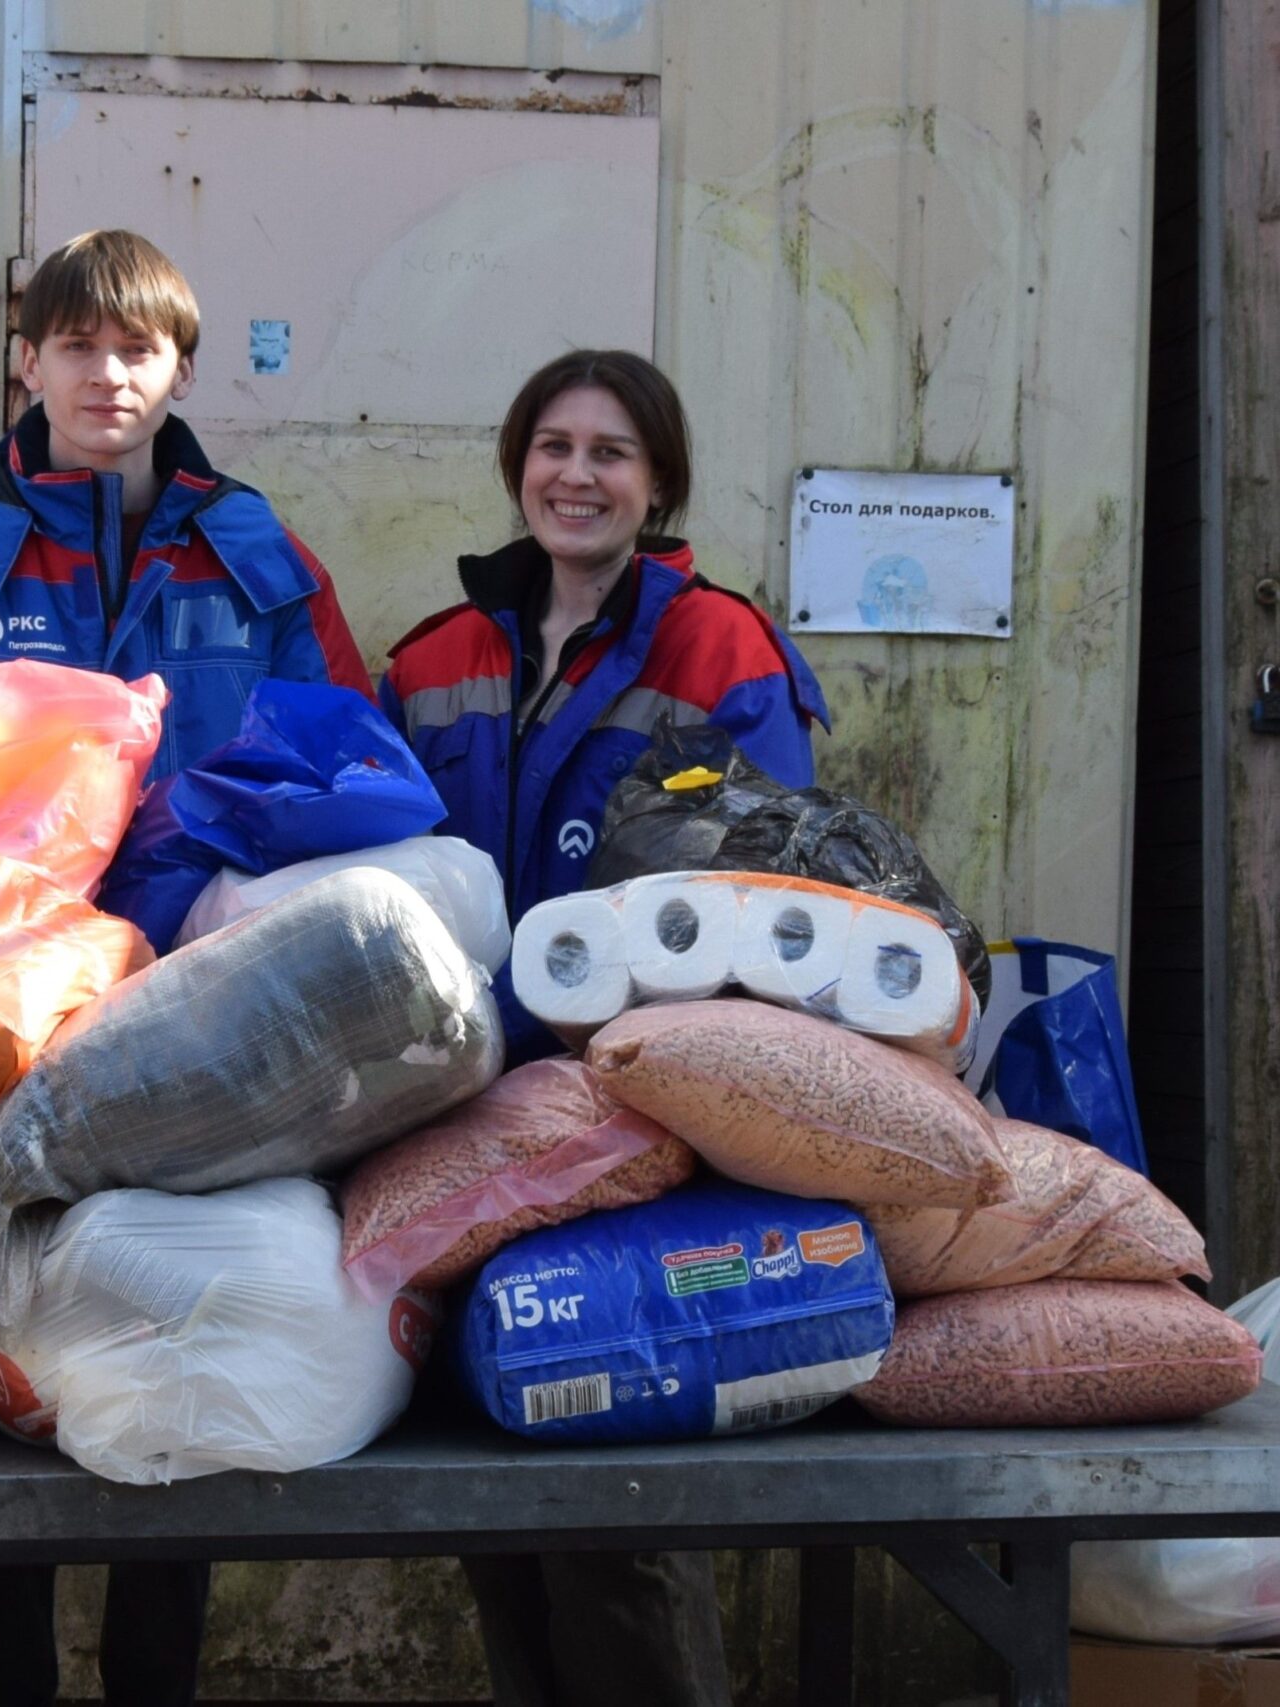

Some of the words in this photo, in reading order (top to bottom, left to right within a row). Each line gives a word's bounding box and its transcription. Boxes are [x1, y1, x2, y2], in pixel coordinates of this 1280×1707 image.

[809, 499, 853, 514] Стол
[858, 502, 893, 517] для
[899, 504, 996, 521] подарков.
[8, 616, 47, 631] РКС
[752, 1251, 796, 1279] Chappi
[489, 1274, 532, 1295] Масса
[534, 1267, 580, 1282] нетто:
[492, 1284, 544, 1331] 15
[548, 1294, 585, 1323] кг
